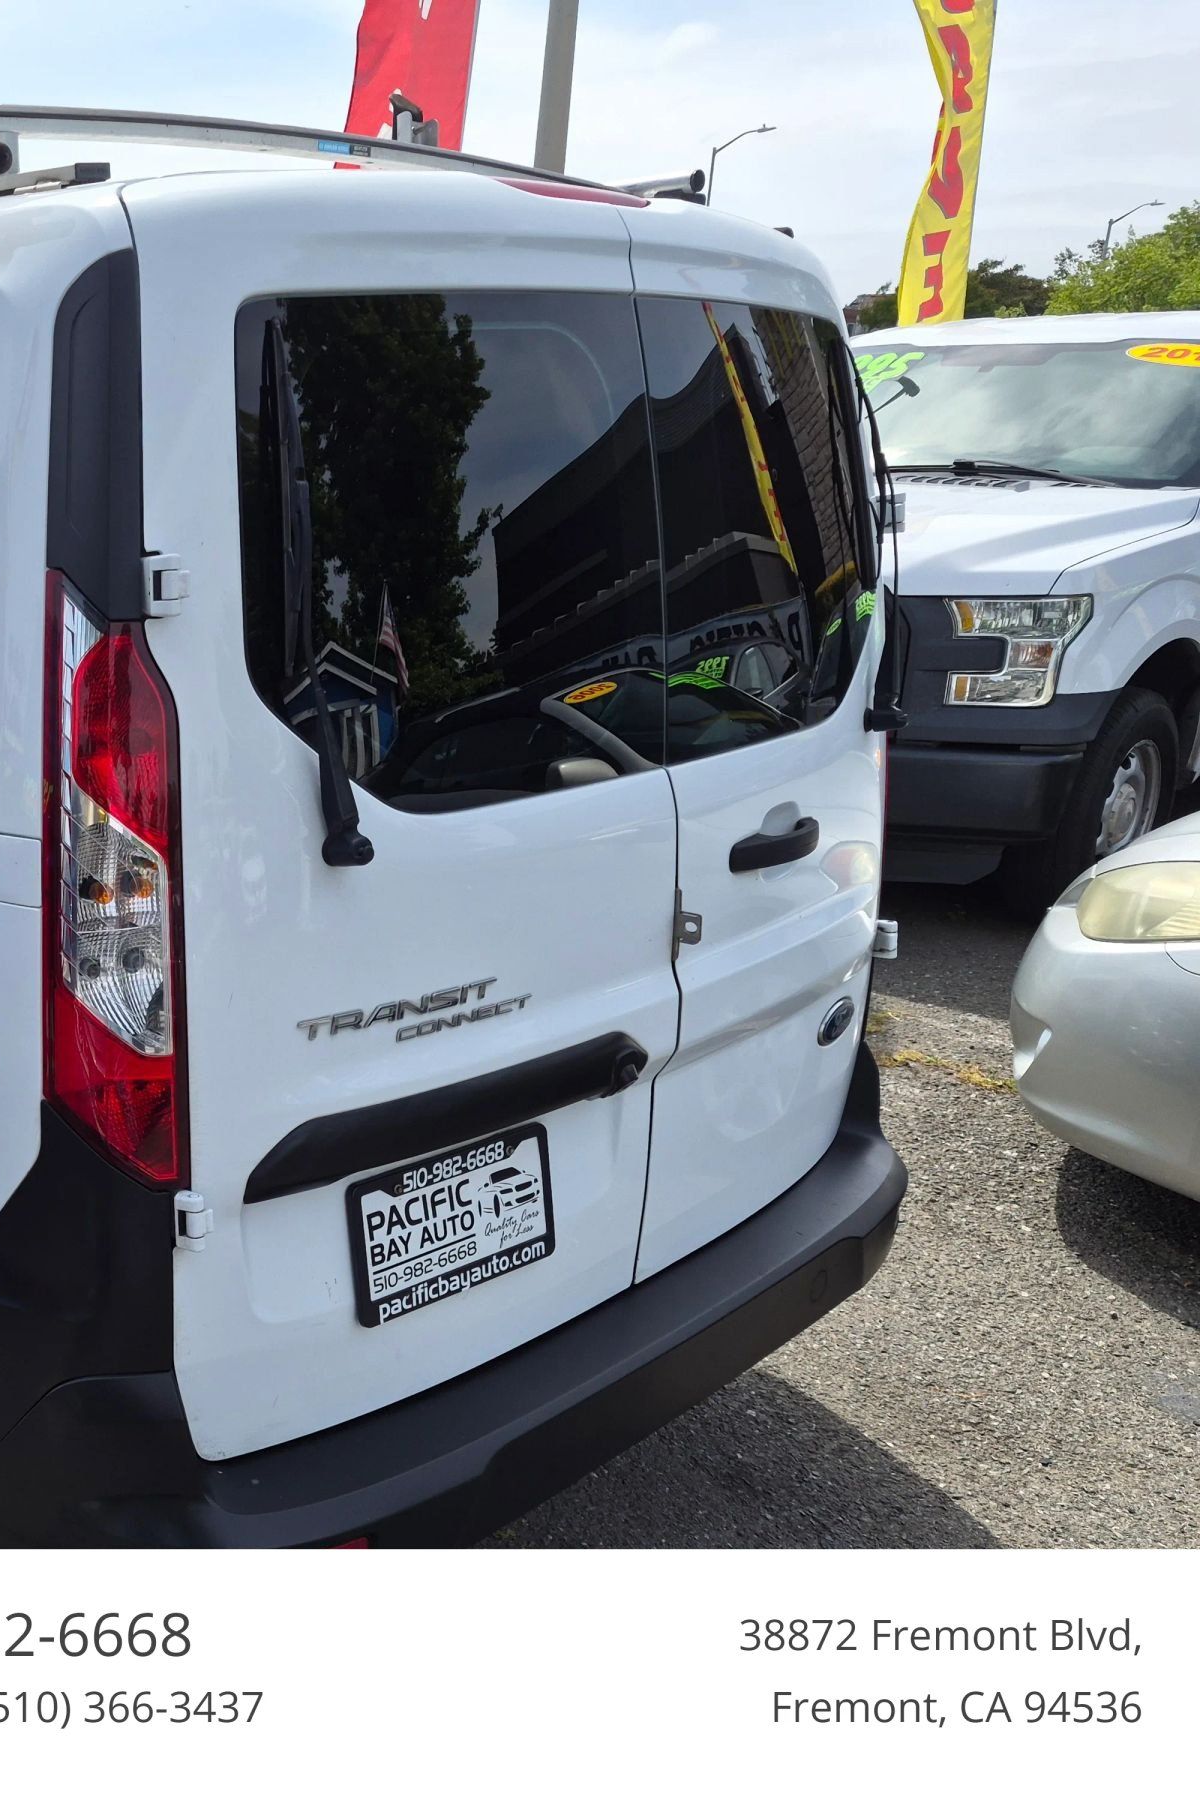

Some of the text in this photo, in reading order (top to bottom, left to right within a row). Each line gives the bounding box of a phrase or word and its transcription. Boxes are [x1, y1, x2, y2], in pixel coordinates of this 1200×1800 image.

[296, 976, 498, 1041] TRANSIT
[396, 993, 533, 1043] CONNECT
[402, 1140, 505, 1194] 510-982-6668
[366, 1178, 473, 1242] PACIFIC
[484, 1216, 518, 1237] Quality
[499, 1222, 535, 1249] for Less
[370, 1210, 475, 1267] BAY AUTO
[373, 1240, 478, 1294] 510-982-6668
[378, 1240, 546, 1325] pacificbayauto.com
